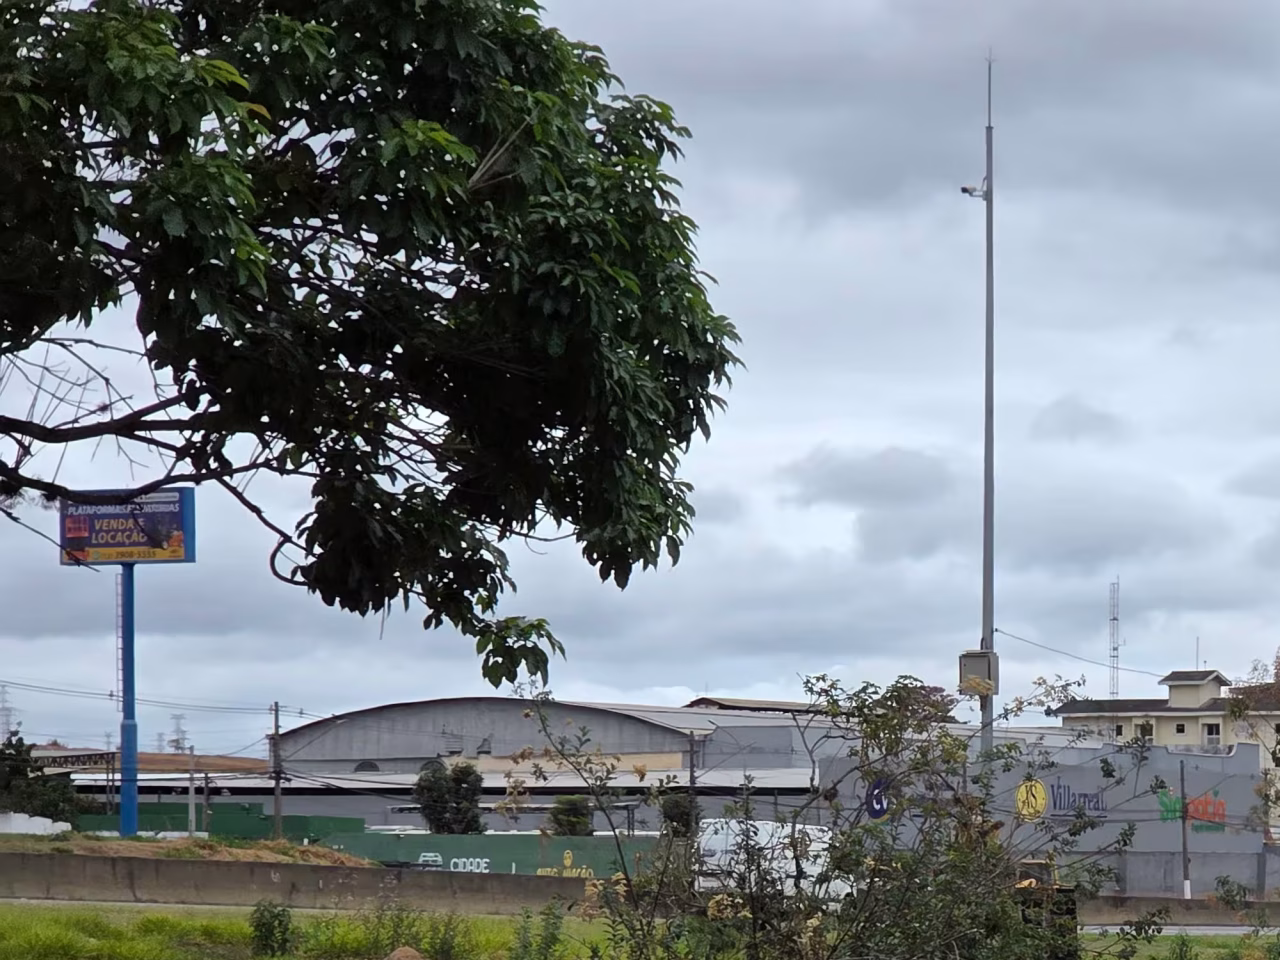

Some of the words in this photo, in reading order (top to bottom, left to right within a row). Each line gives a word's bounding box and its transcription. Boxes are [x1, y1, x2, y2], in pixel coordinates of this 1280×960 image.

[94, 518, 134, 530] VENDA
[91, 530, 147, 545] LOCAÇÃO
[450, 858, 491, 874] CIDADE
